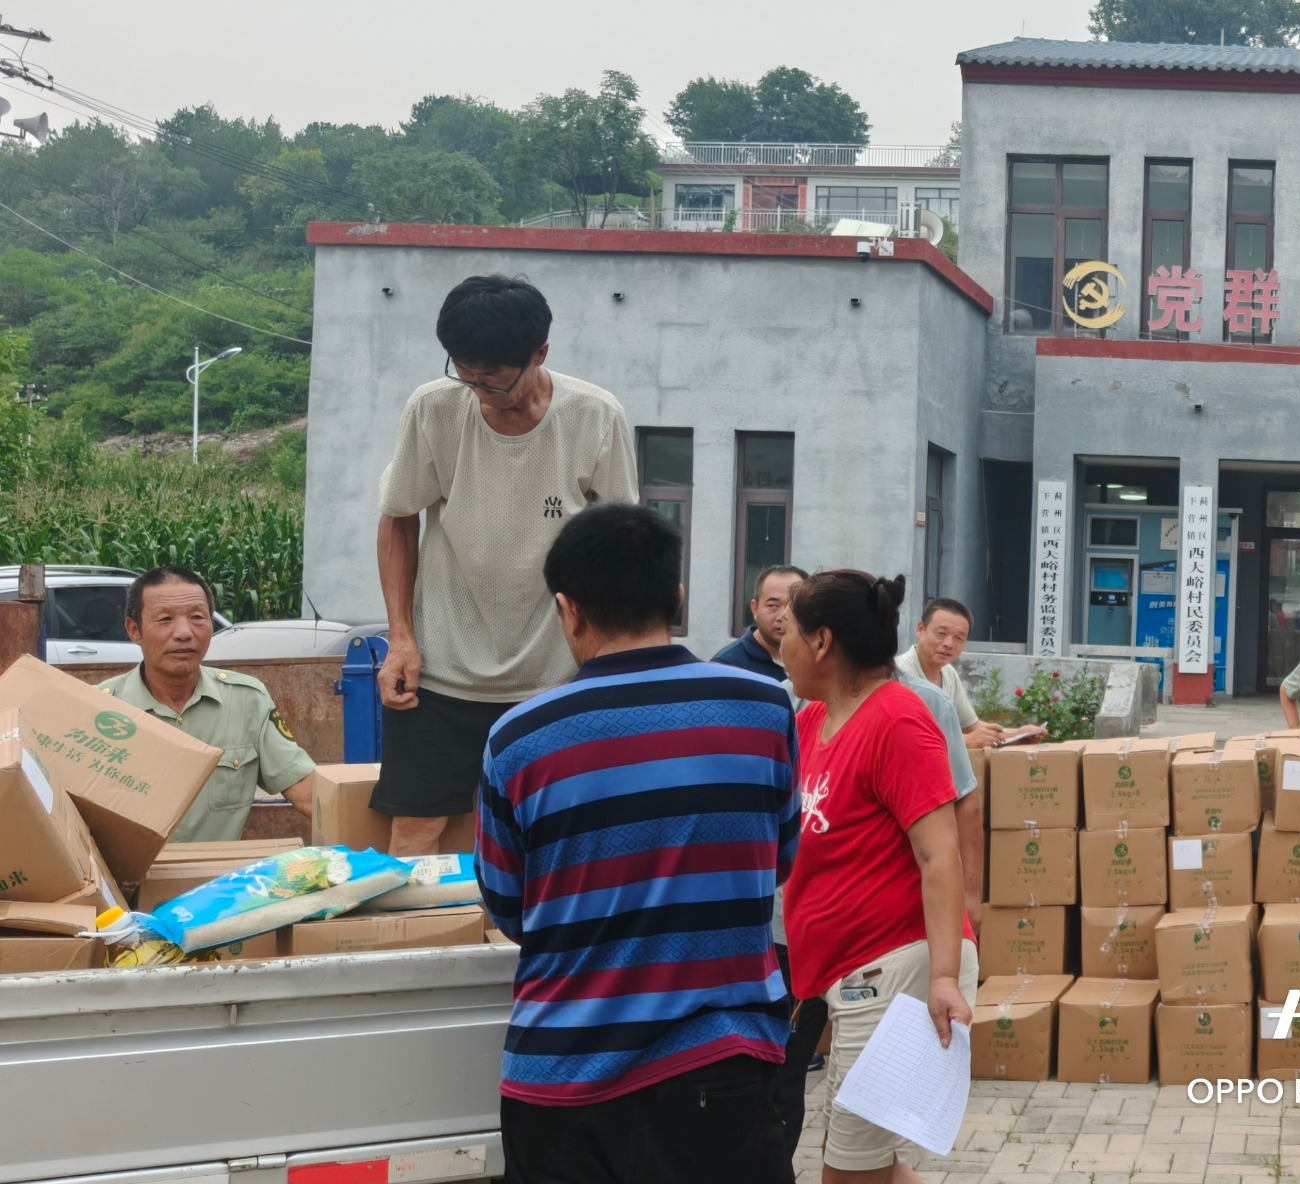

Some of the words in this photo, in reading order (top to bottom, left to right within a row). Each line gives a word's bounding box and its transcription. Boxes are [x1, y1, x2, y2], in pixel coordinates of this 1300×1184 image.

[1041, 492, 1050, 535] 下营镇
[1187, 496, 1196, 541] 下营镇
[1186, 546, 1206, 663] 西大峪村民委员会
[89, 758, 150, 795] 为你而来
